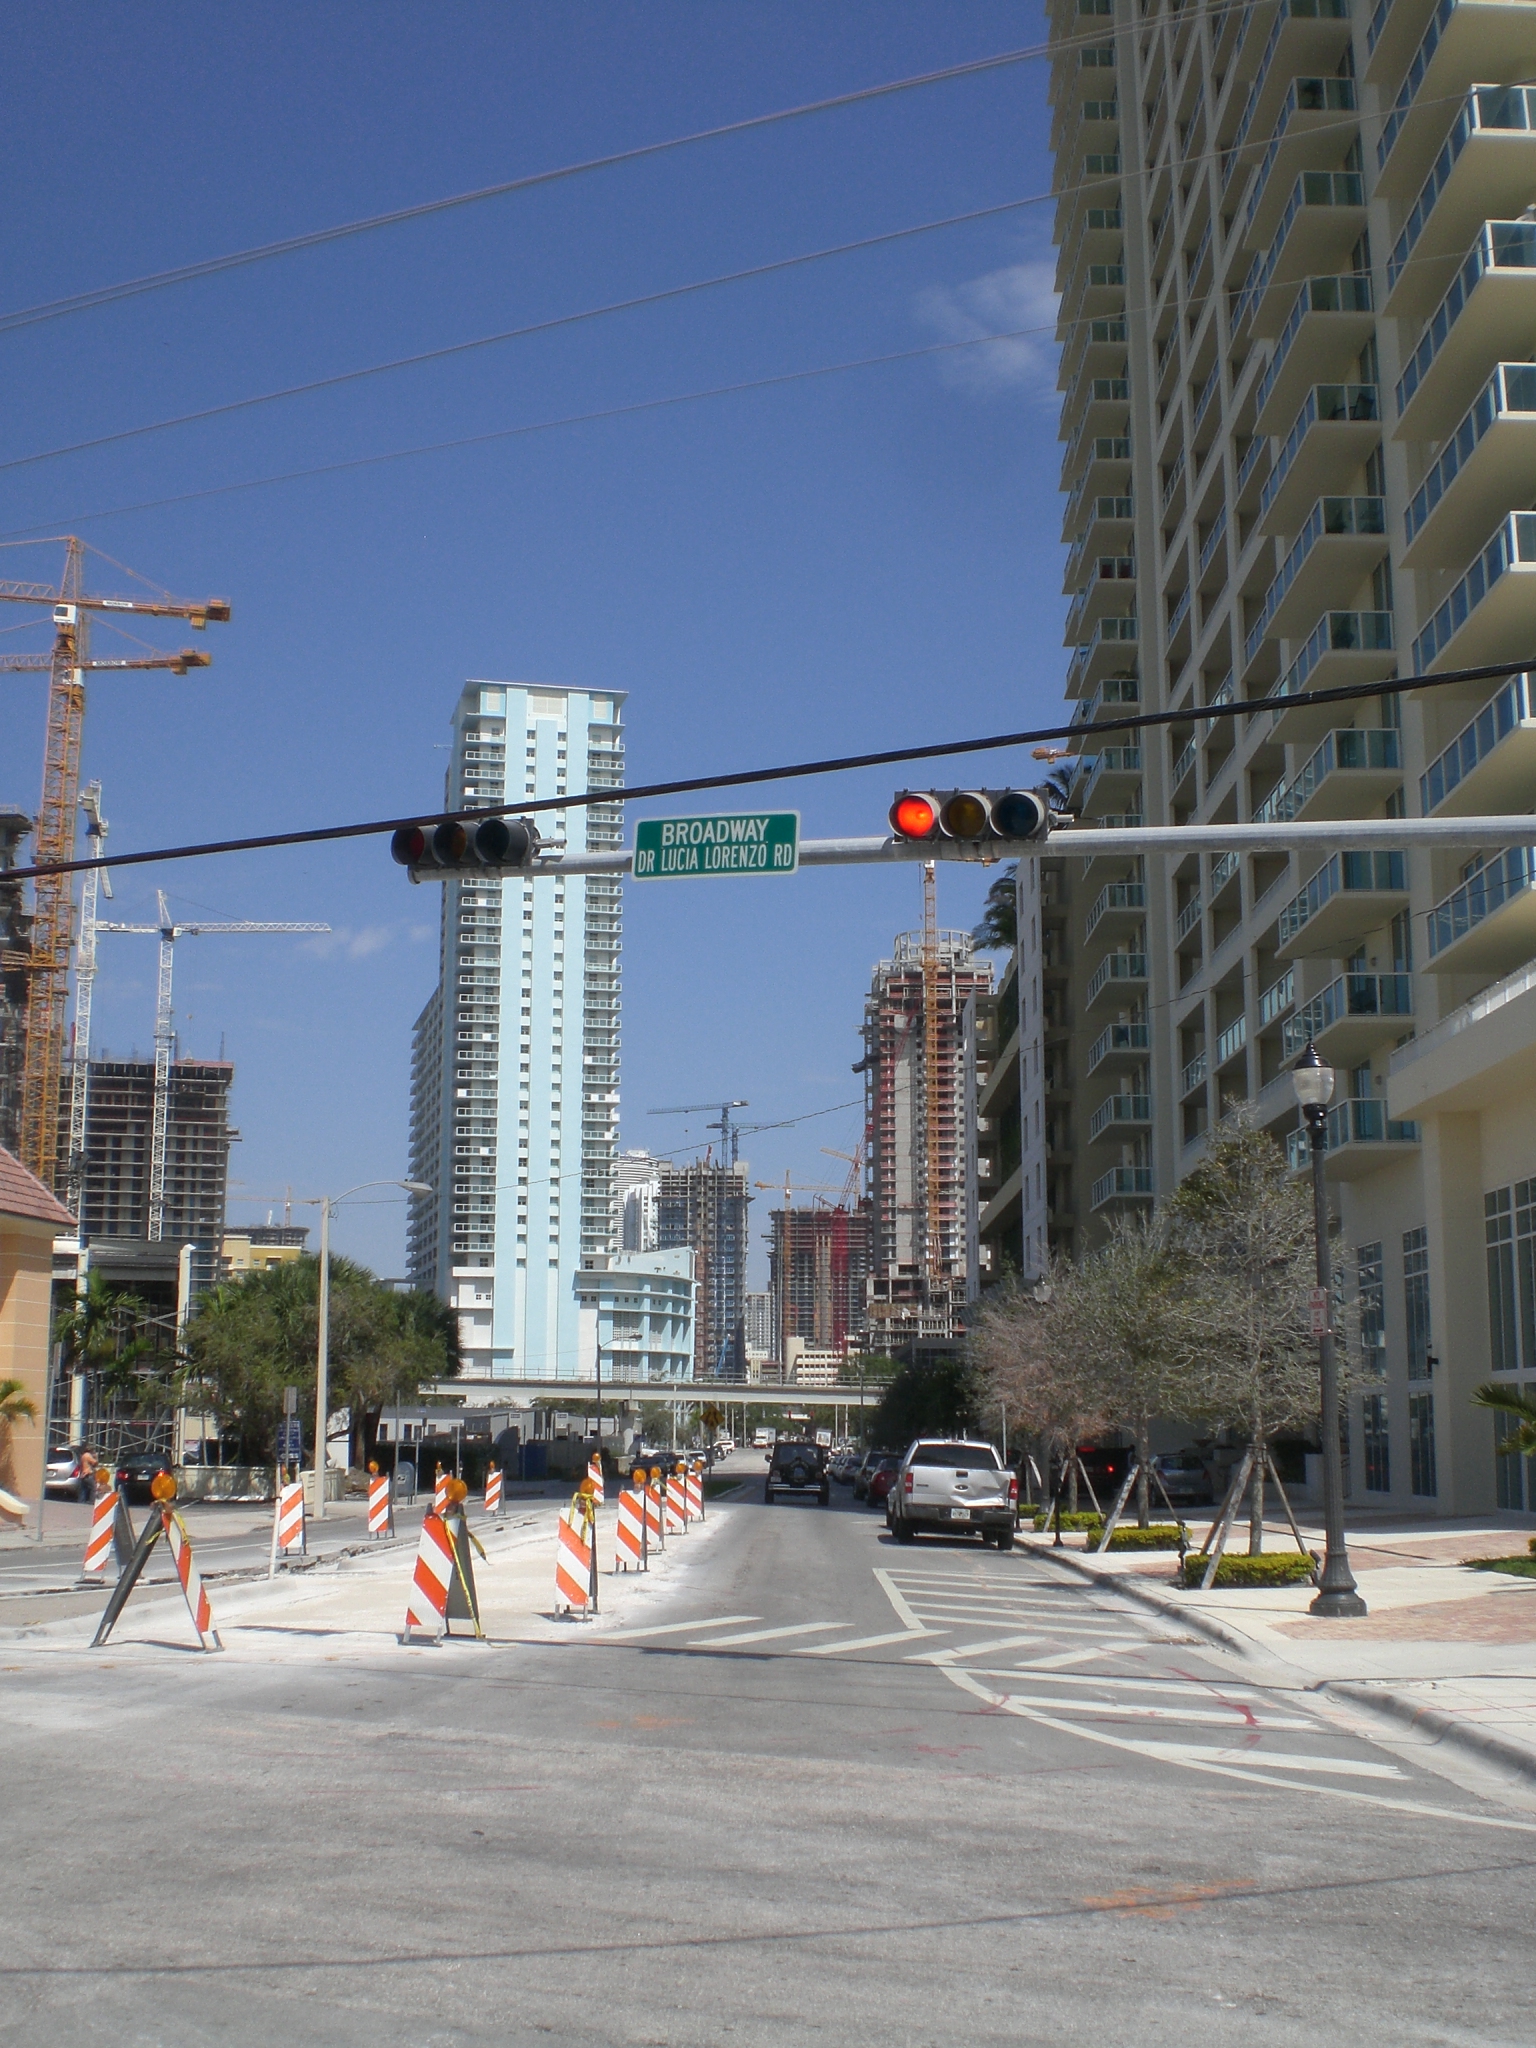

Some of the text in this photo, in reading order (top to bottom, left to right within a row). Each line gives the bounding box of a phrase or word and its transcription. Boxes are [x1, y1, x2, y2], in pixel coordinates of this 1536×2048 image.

[661, 819, 770, 846] BROADWAY
[637, 844, 792, 873] DR LUCIA LORENZO RD
